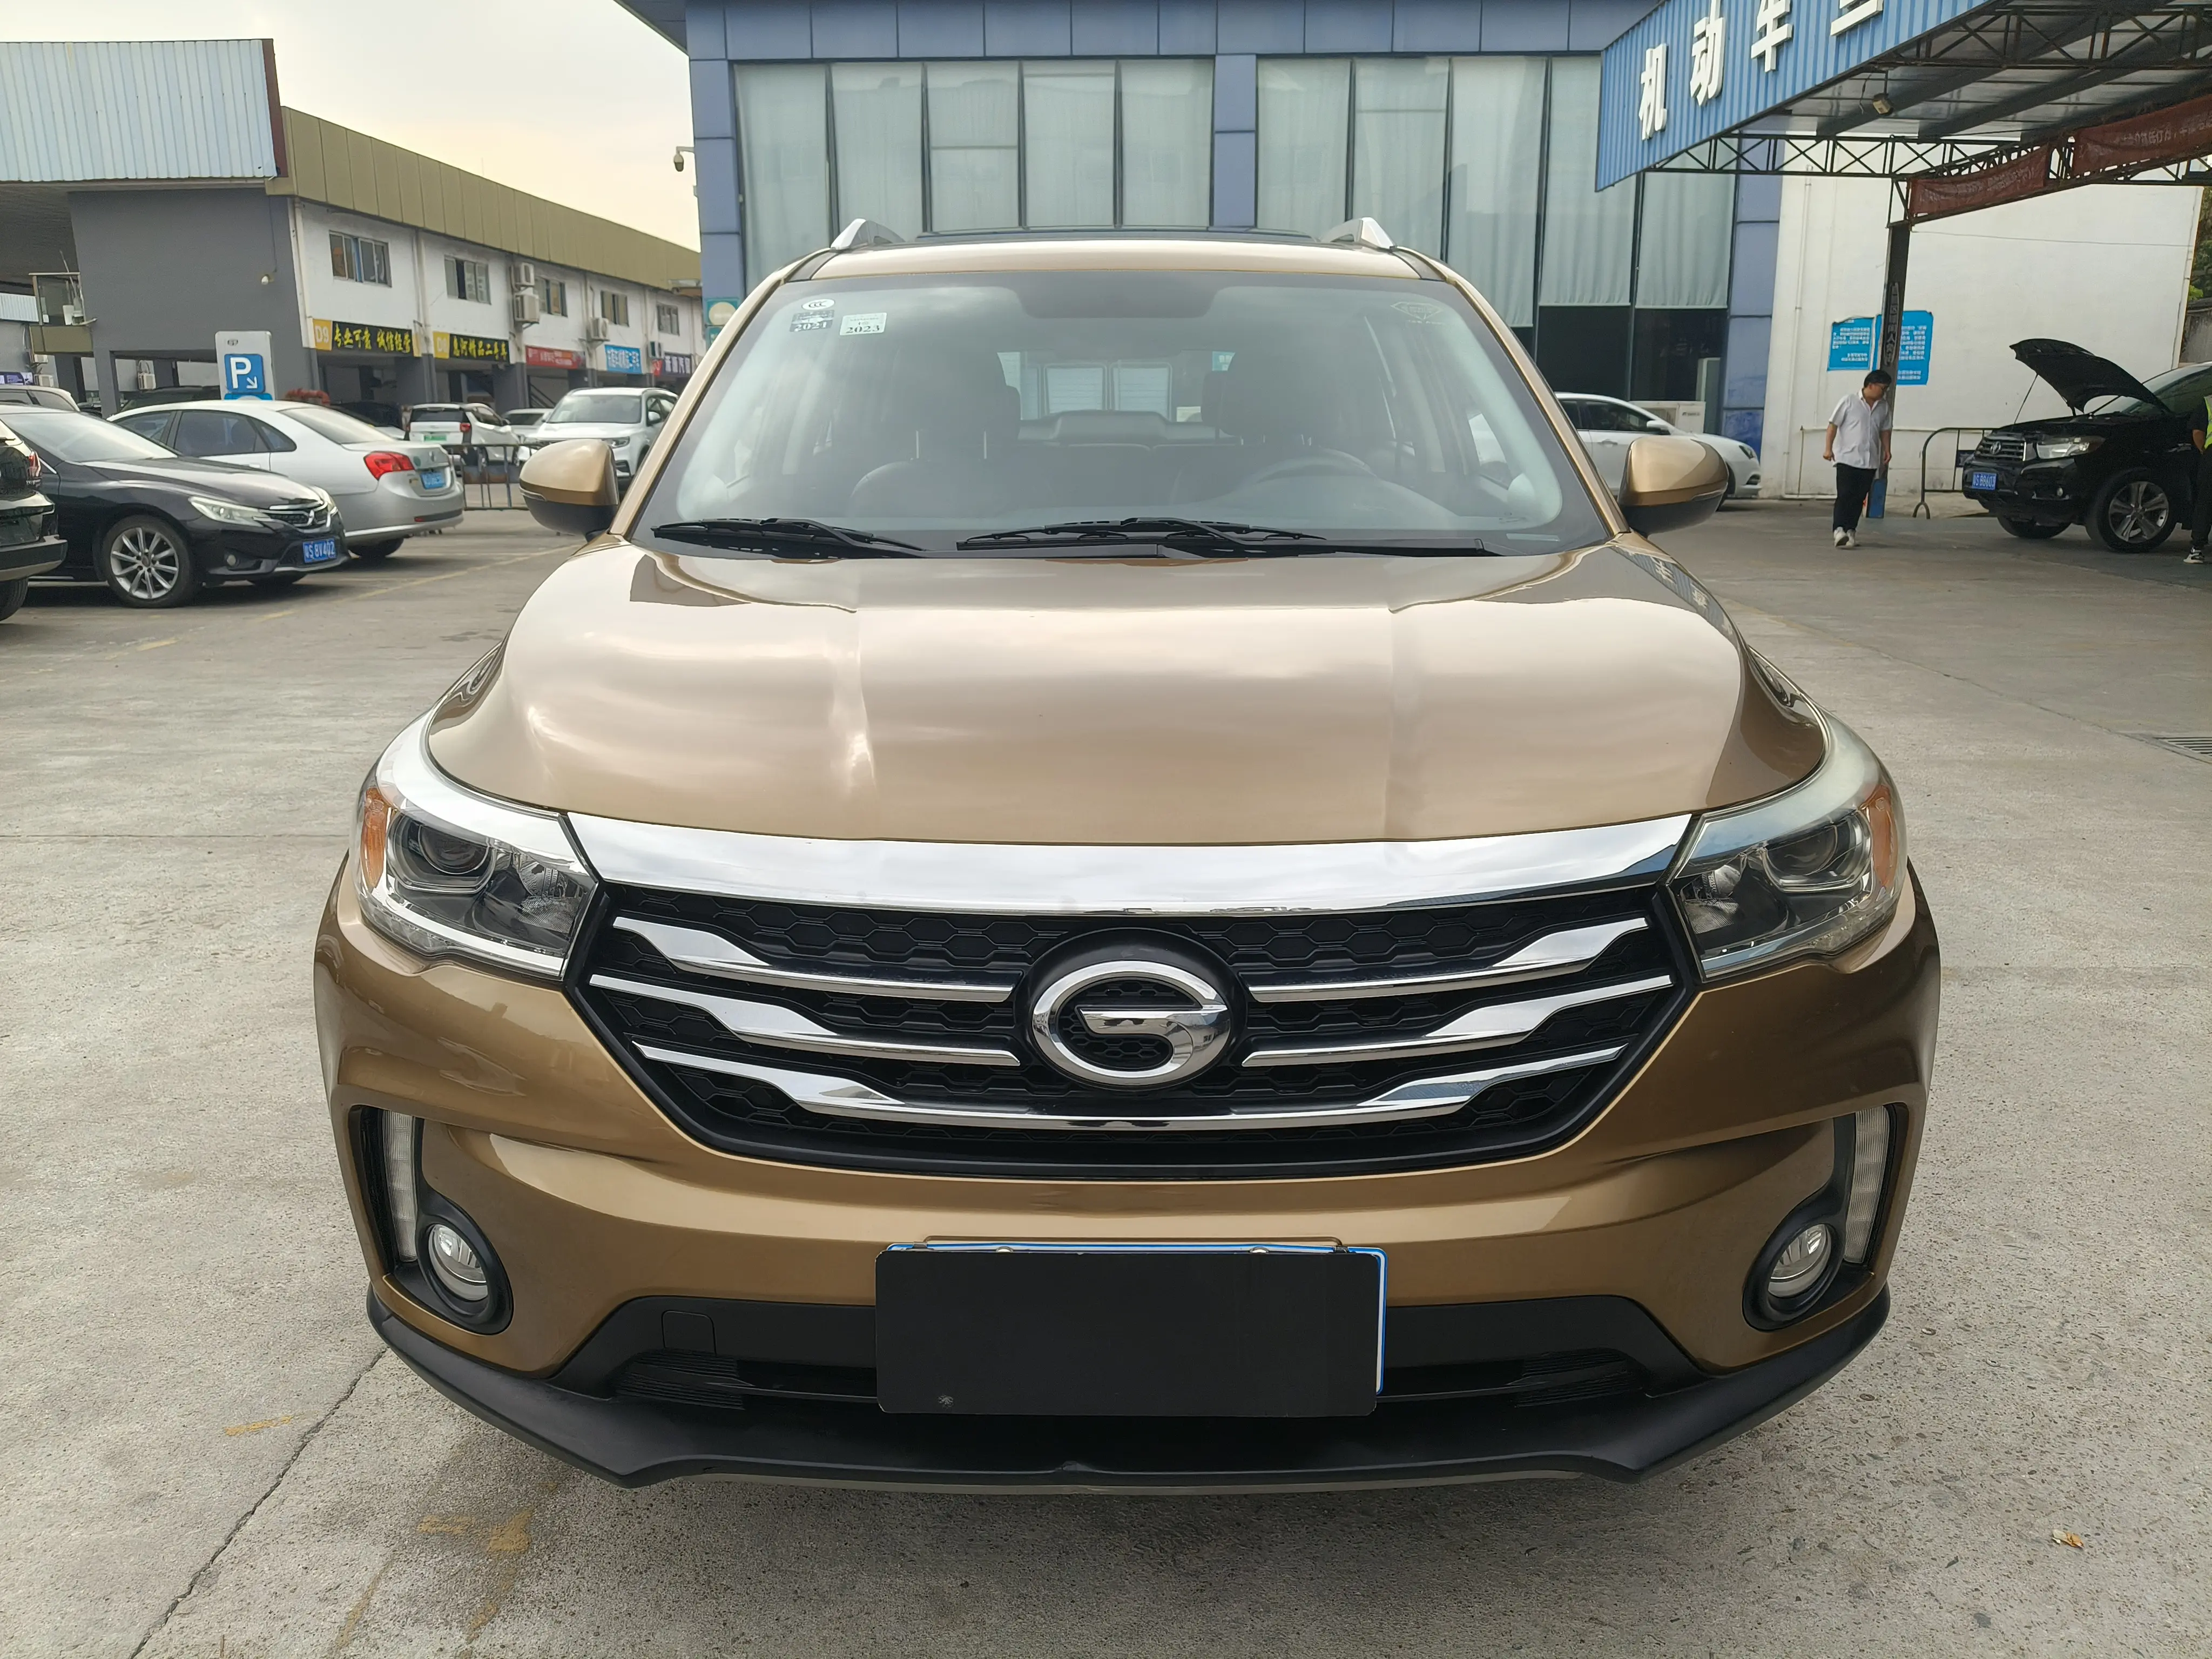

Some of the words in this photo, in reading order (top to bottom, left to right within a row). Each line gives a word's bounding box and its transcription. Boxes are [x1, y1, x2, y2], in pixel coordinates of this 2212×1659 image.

[315, 326, 329, 343] D9
[794, 321, 827, 332] 2021
[846, 325, 880, 334] 2023
[334, 323, 372, 350] 专业可靠
[230, 356, 252, 389] P
